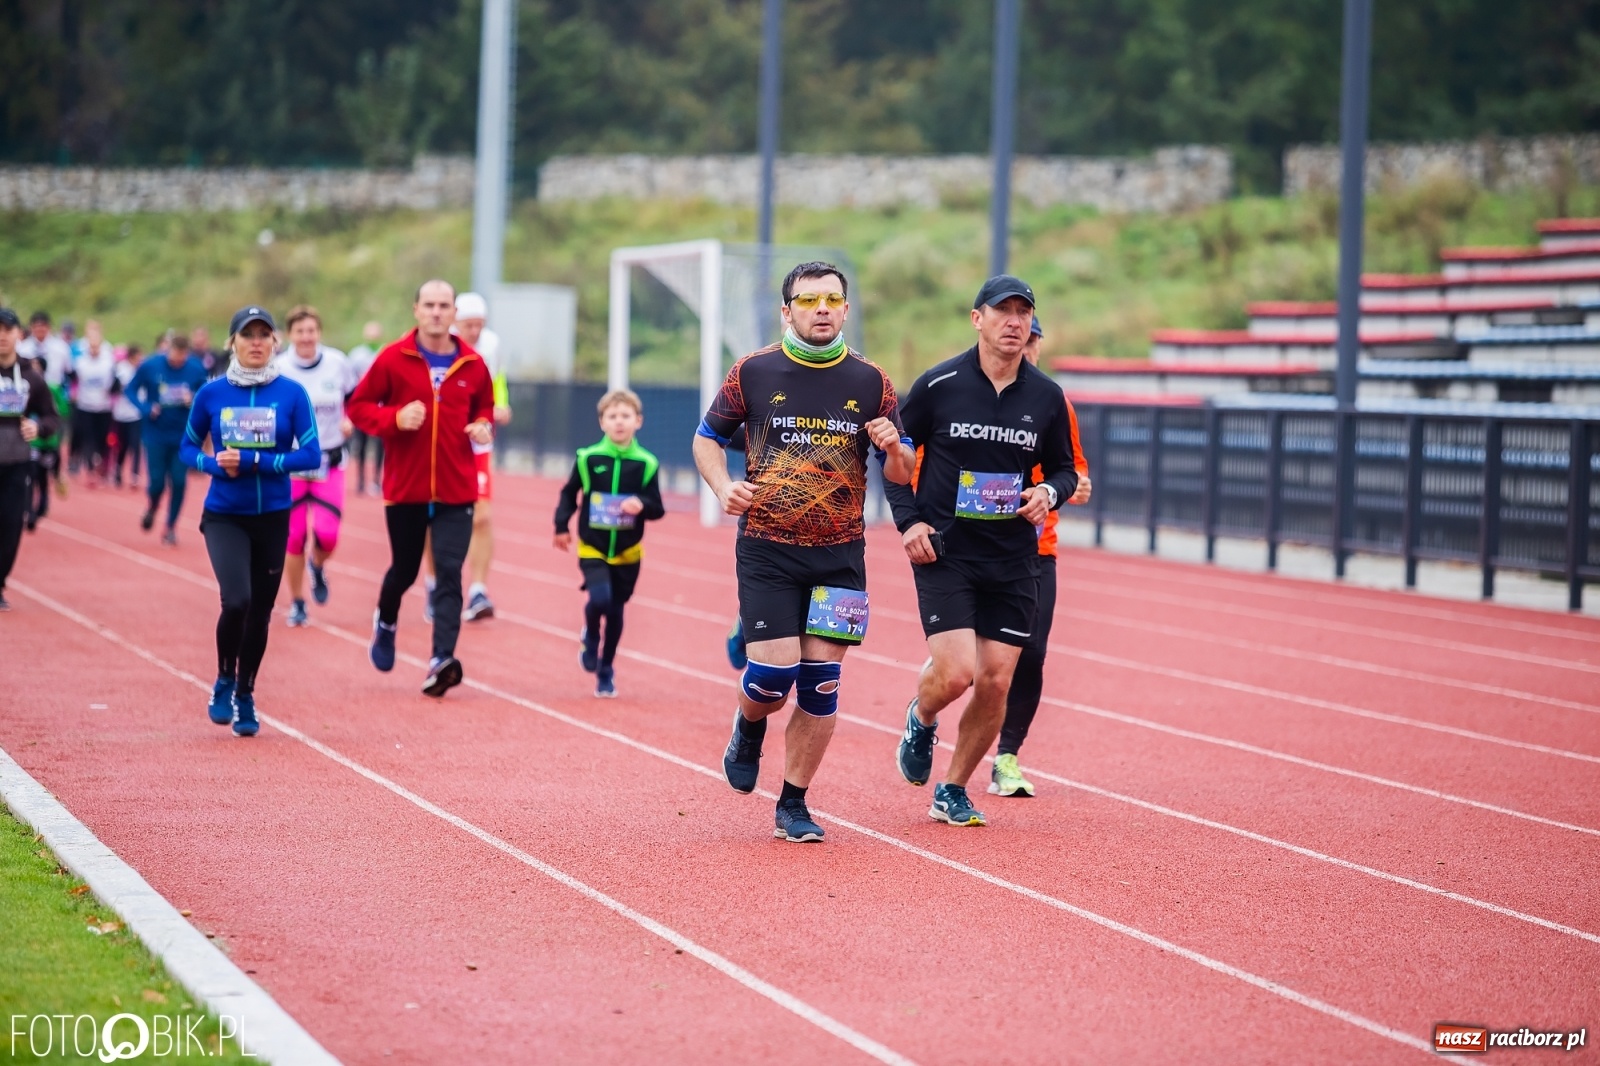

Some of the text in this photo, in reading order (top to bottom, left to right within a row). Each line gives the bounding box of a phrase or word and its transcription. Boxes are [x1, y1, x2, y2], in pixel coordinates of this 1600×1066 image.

[772, 416, 859, 435] PIERUNSKIE
[780, 432, 849, 446] CANGÓRY
[950, 422, 1038, 447] DECATHLON
[995, 504, 1015, 514] 222
[835, 605, 847, 613] DLA
[846, 623, 864, 636] 174
